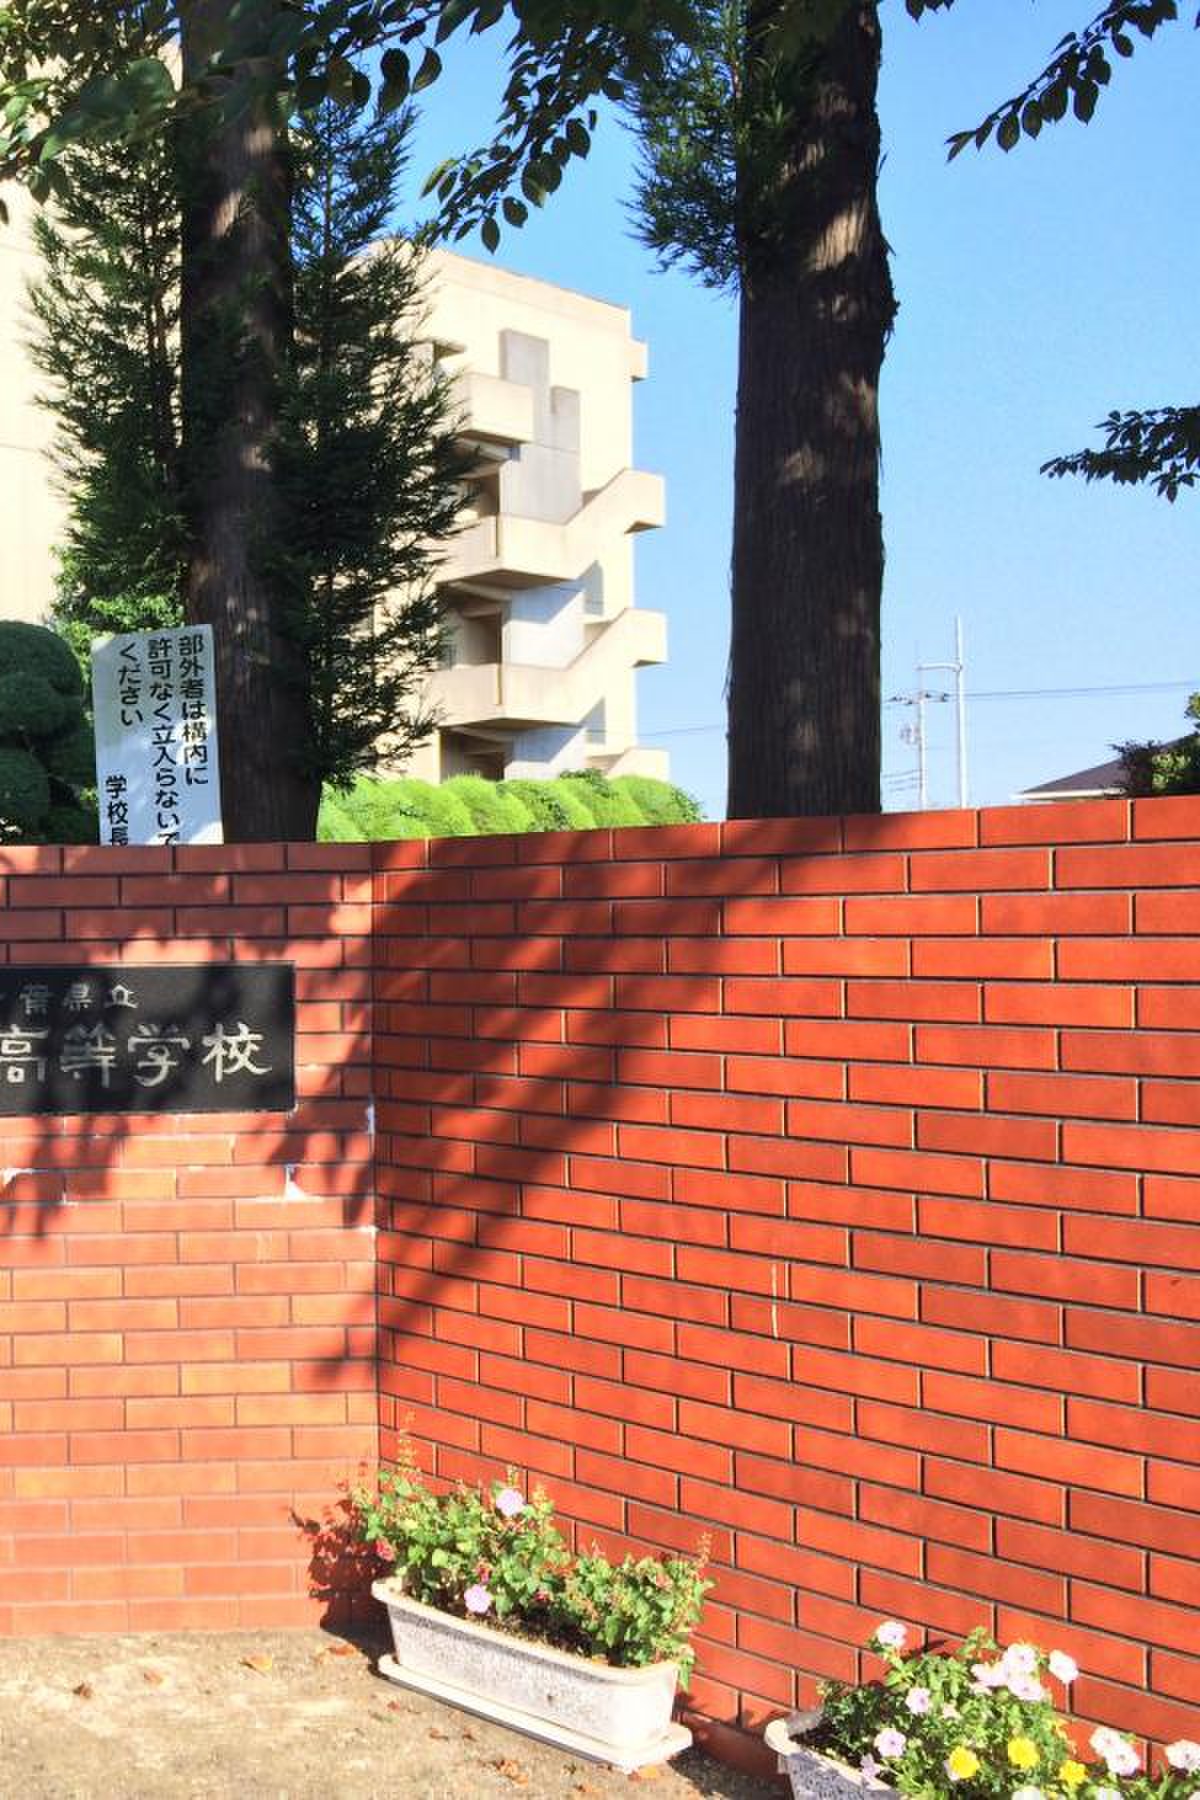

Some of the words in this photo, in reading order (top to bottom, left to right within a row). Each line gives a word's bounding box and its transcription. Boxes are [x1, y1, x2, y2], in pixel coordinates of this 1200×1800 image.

[118, 641, 143, 727] ください
[177, 634, 210, 786] 部外者は構内に
[105, 775, 129, 846] 学校長
